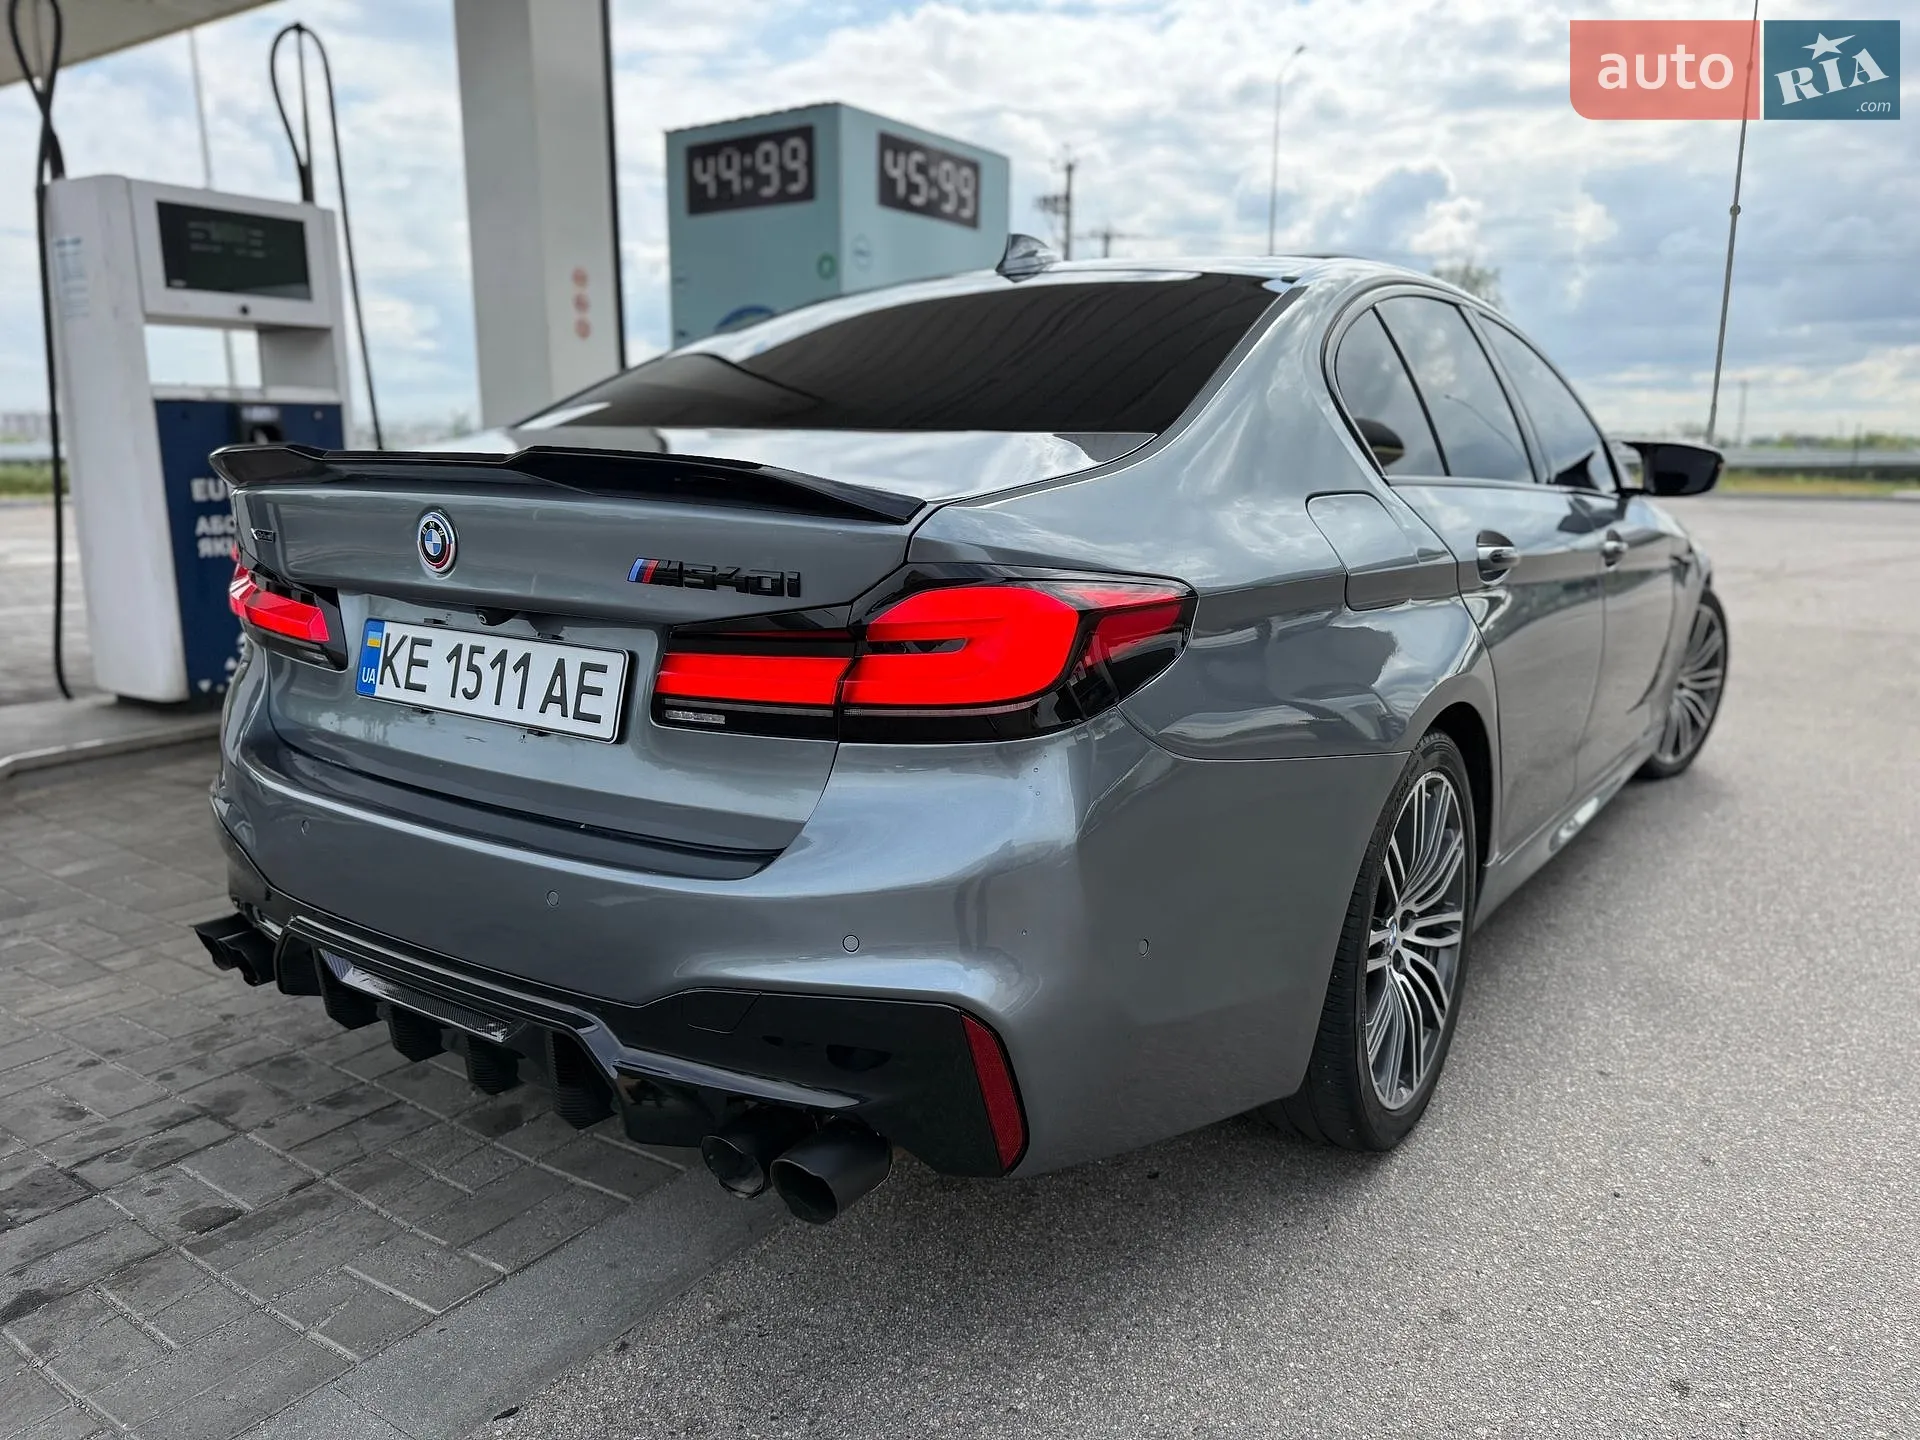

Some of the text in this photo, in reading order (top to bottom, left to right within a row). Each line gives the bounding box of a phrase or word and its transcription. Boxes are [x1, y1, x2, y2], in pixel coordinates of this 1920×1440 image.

[361, 666, 376, 685] UA
[379, 632, 608, 724] KE 1511 AE
